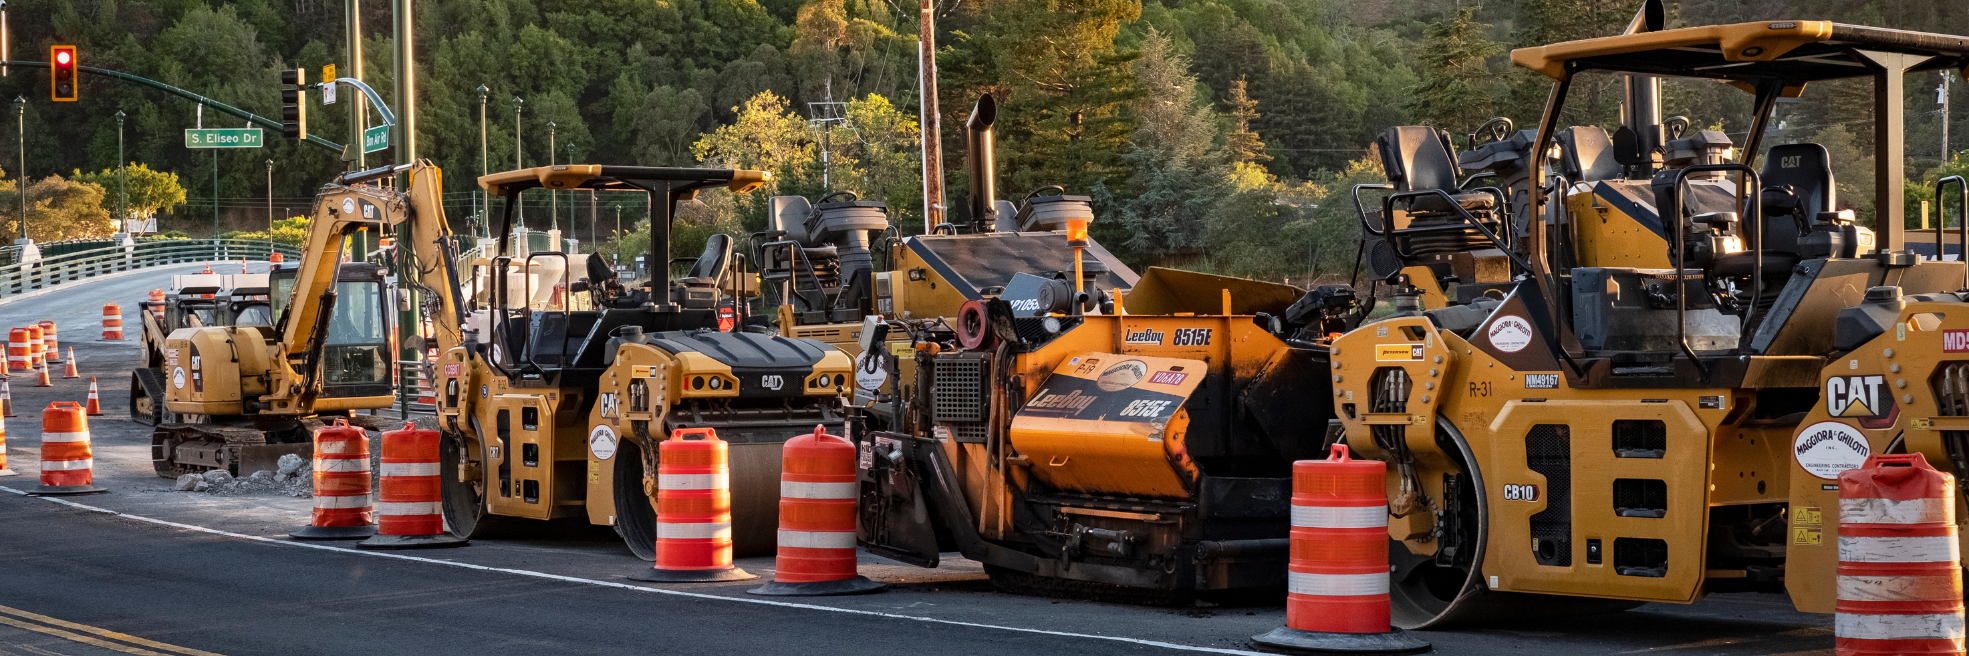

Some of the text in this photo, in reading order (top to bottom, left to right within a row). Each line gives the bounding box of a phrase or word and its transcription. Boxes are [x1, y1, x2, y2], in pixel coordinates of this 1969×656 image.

[192, 133, 257, 143] S. Eliseo Dr
[381, 131, 387, 144] Rd
[1781, 155, 1801, 169] CAT
[363, 204, 375, 219] CAT
[1010, 298, 1040, 311] P1055
[1490, 320, 1511, 338] MAGGIORA
[1513, 320, 1531, 338] GHILOTTI
[1125, 328, 1213, 346] LeeBoy 8515E
[1412, 347, 1423, 357] CAT
[191, 355, 201, 370] CAT
[1074, 363, 1096, 375] P-19
[762, 375, 779, 388] CAT
[1153, 371, 1185, 385] VD6A78
[1525, 373, 1559, 386] NM49167
[1469, 381, 1493, 398] R-31
[1827, 375, 1883, 418] CAT
[1025, 388, 1173, 418] LeeBoy 8515E
[1796, 429, 1834, 456] MAGGIORA
[1837, 430, 1869, 458] GHILOTTI
[1504, 484, 1534, 501] CB10
